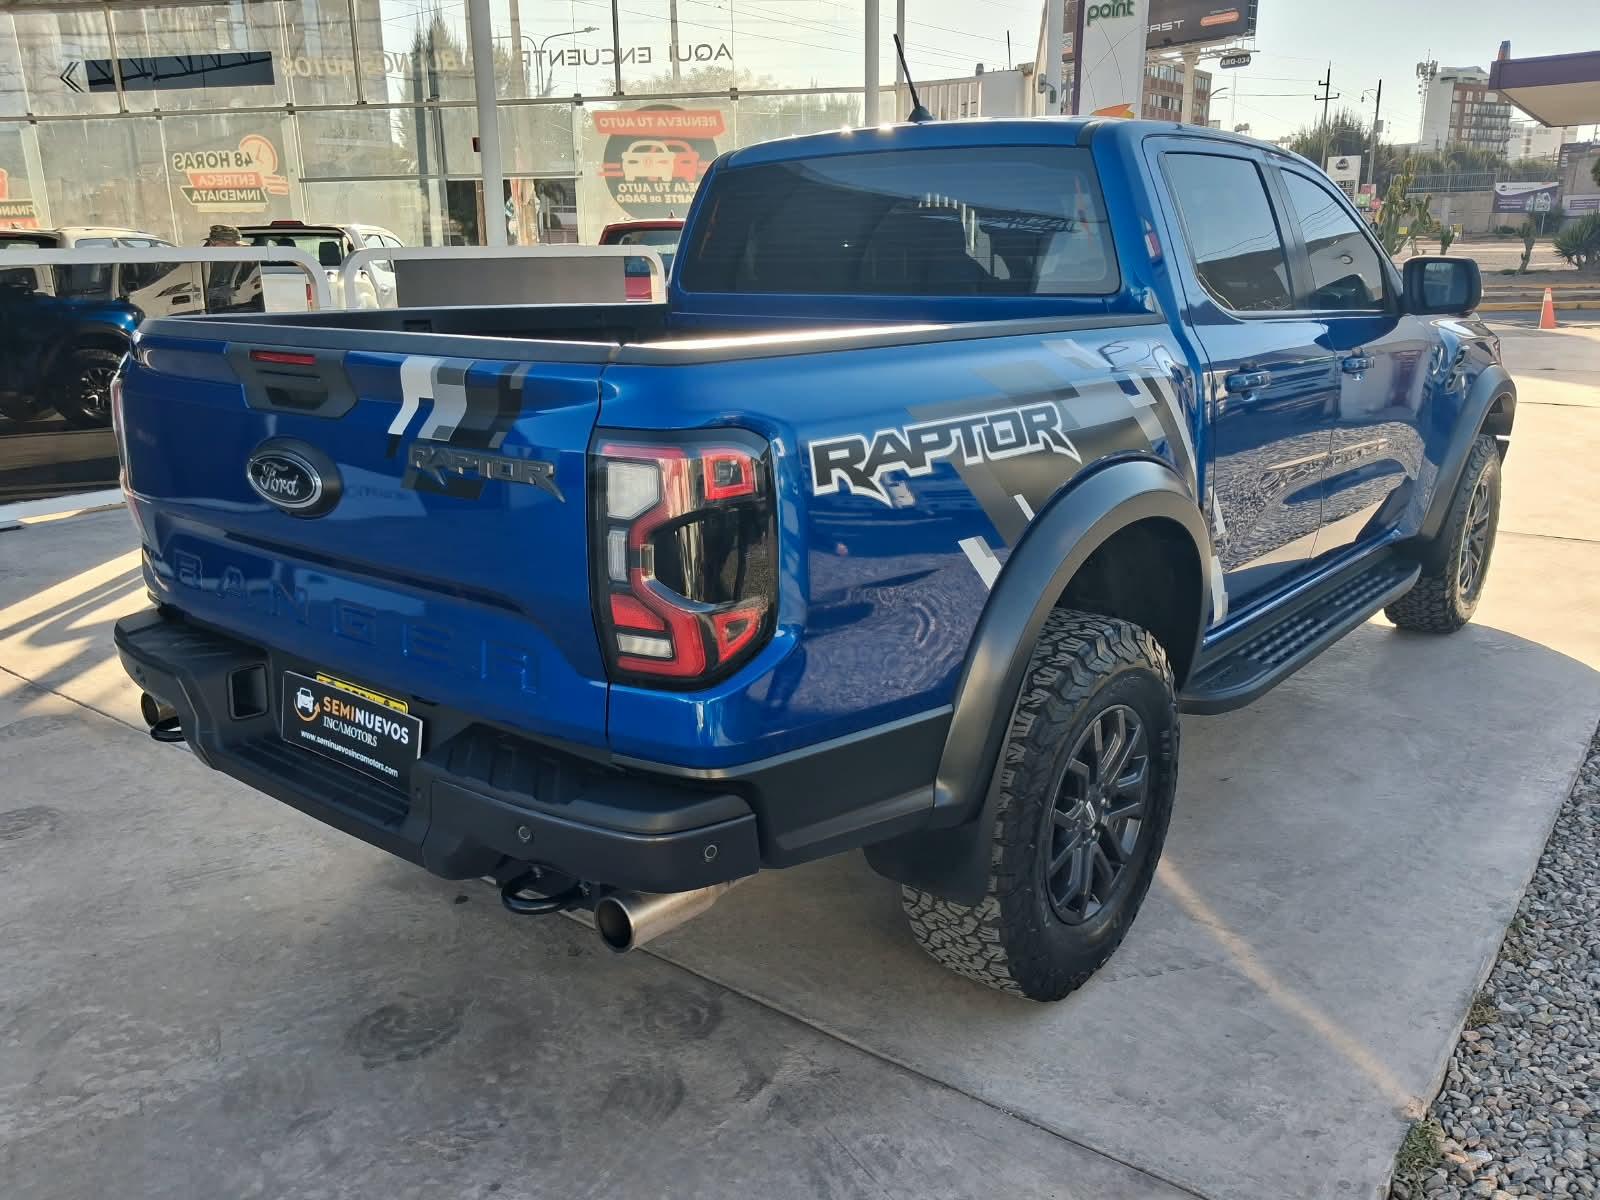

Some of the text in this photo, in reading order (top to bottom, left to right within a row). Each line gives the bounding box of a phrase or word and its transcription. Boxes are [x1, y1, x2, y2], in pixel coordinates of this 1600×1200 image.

[1087, 0, 1135, 27] point
[255, 461, 299, 496] Ford
[409, 443, 567, 503] RAPTOR
[808, 401, 1082, 509] RAPTOR
[175, 550, 538, 694] RANGER
[323, 695, 409, 745] SEMINUEVOS
[323, 715, 378, 747] INCAMOTORS
[300, 730, 399, 778] www.seminuevosincamotors.com
